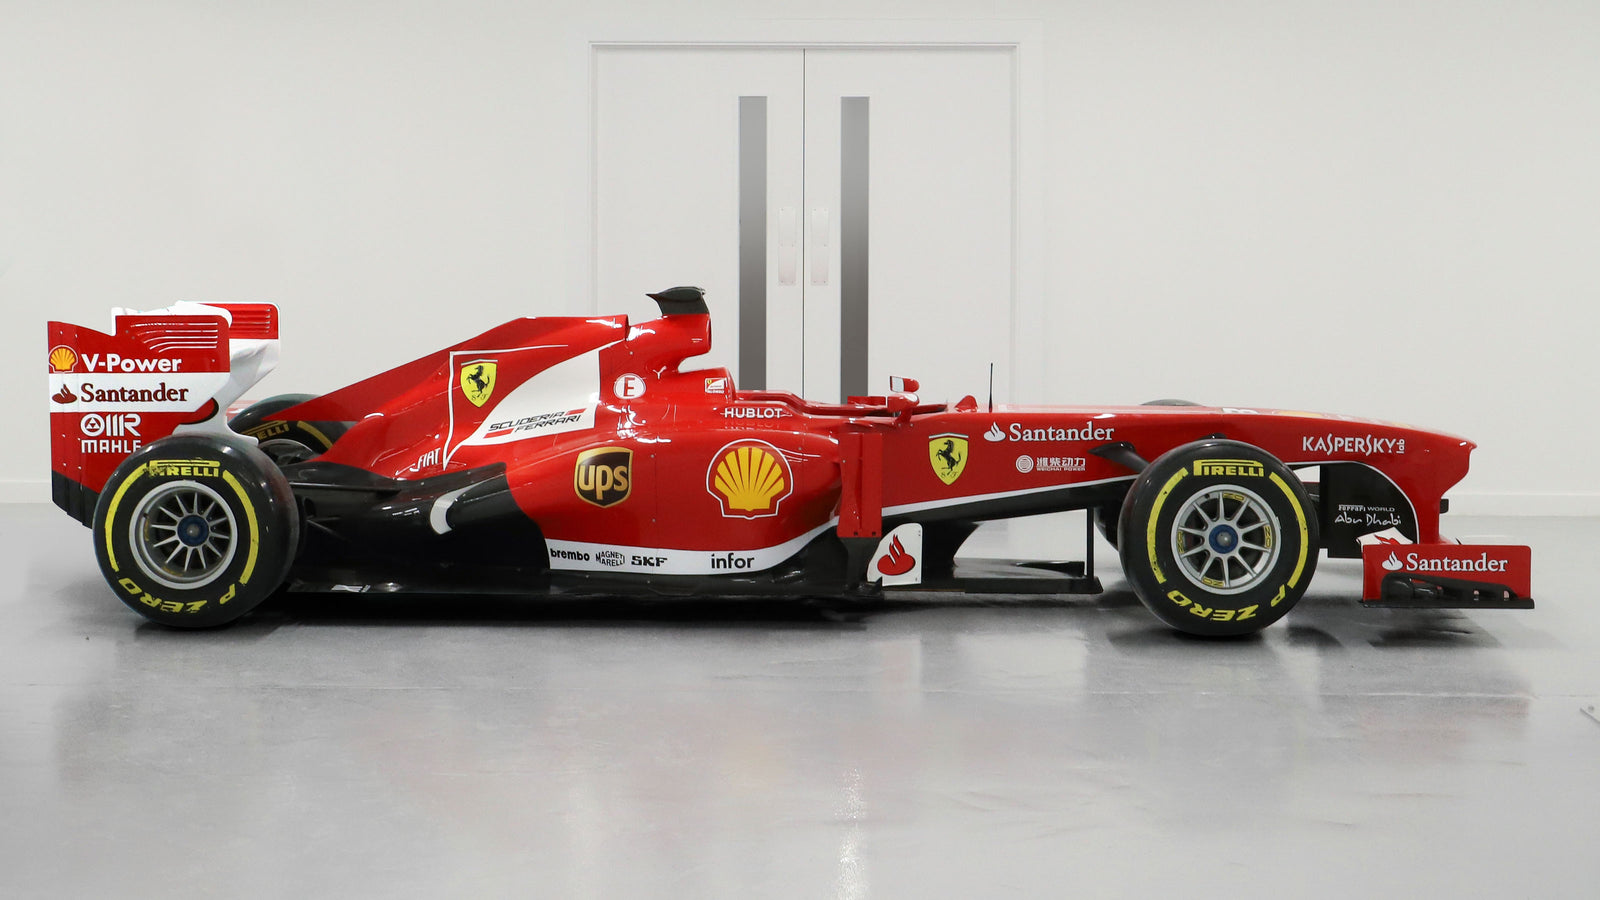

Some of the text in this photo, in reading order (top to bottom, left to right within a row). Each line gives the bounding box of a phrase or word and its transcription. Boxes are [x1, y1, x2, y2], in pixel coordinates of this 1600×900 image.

[81, 353, 182, 373] V-Power
[81, 382, 189, 402] Santander
[623, 377, 636, 397] E
[488, 411, 565, 432] SCUDERIA
[724, 407, 783, 418] HUBLOT
[514, 414, 581, 433] FERRARI
[1009, 421, 1115, 442] Santander
[81, 439, 142, 454] MAHLE
[1302, 433, 1396, 456] KASPERSKY
[409, 447, 442, 472] FIAT
[1193, 459, 1265, 477] PIRELLI
[578, 464, 628, 500] ups
[1334, 511, 1402, 527] Abu Dhabi
[550, 548, 590, 562] brembo
[631, 555, 668, 567] SKF
[711, 552, 755, 569] infor
[1406, 552, 1508, 572] Santander
[118, 577, 236, 614] P ZERO
[1166, 584, 1287, 622] P ZERO
